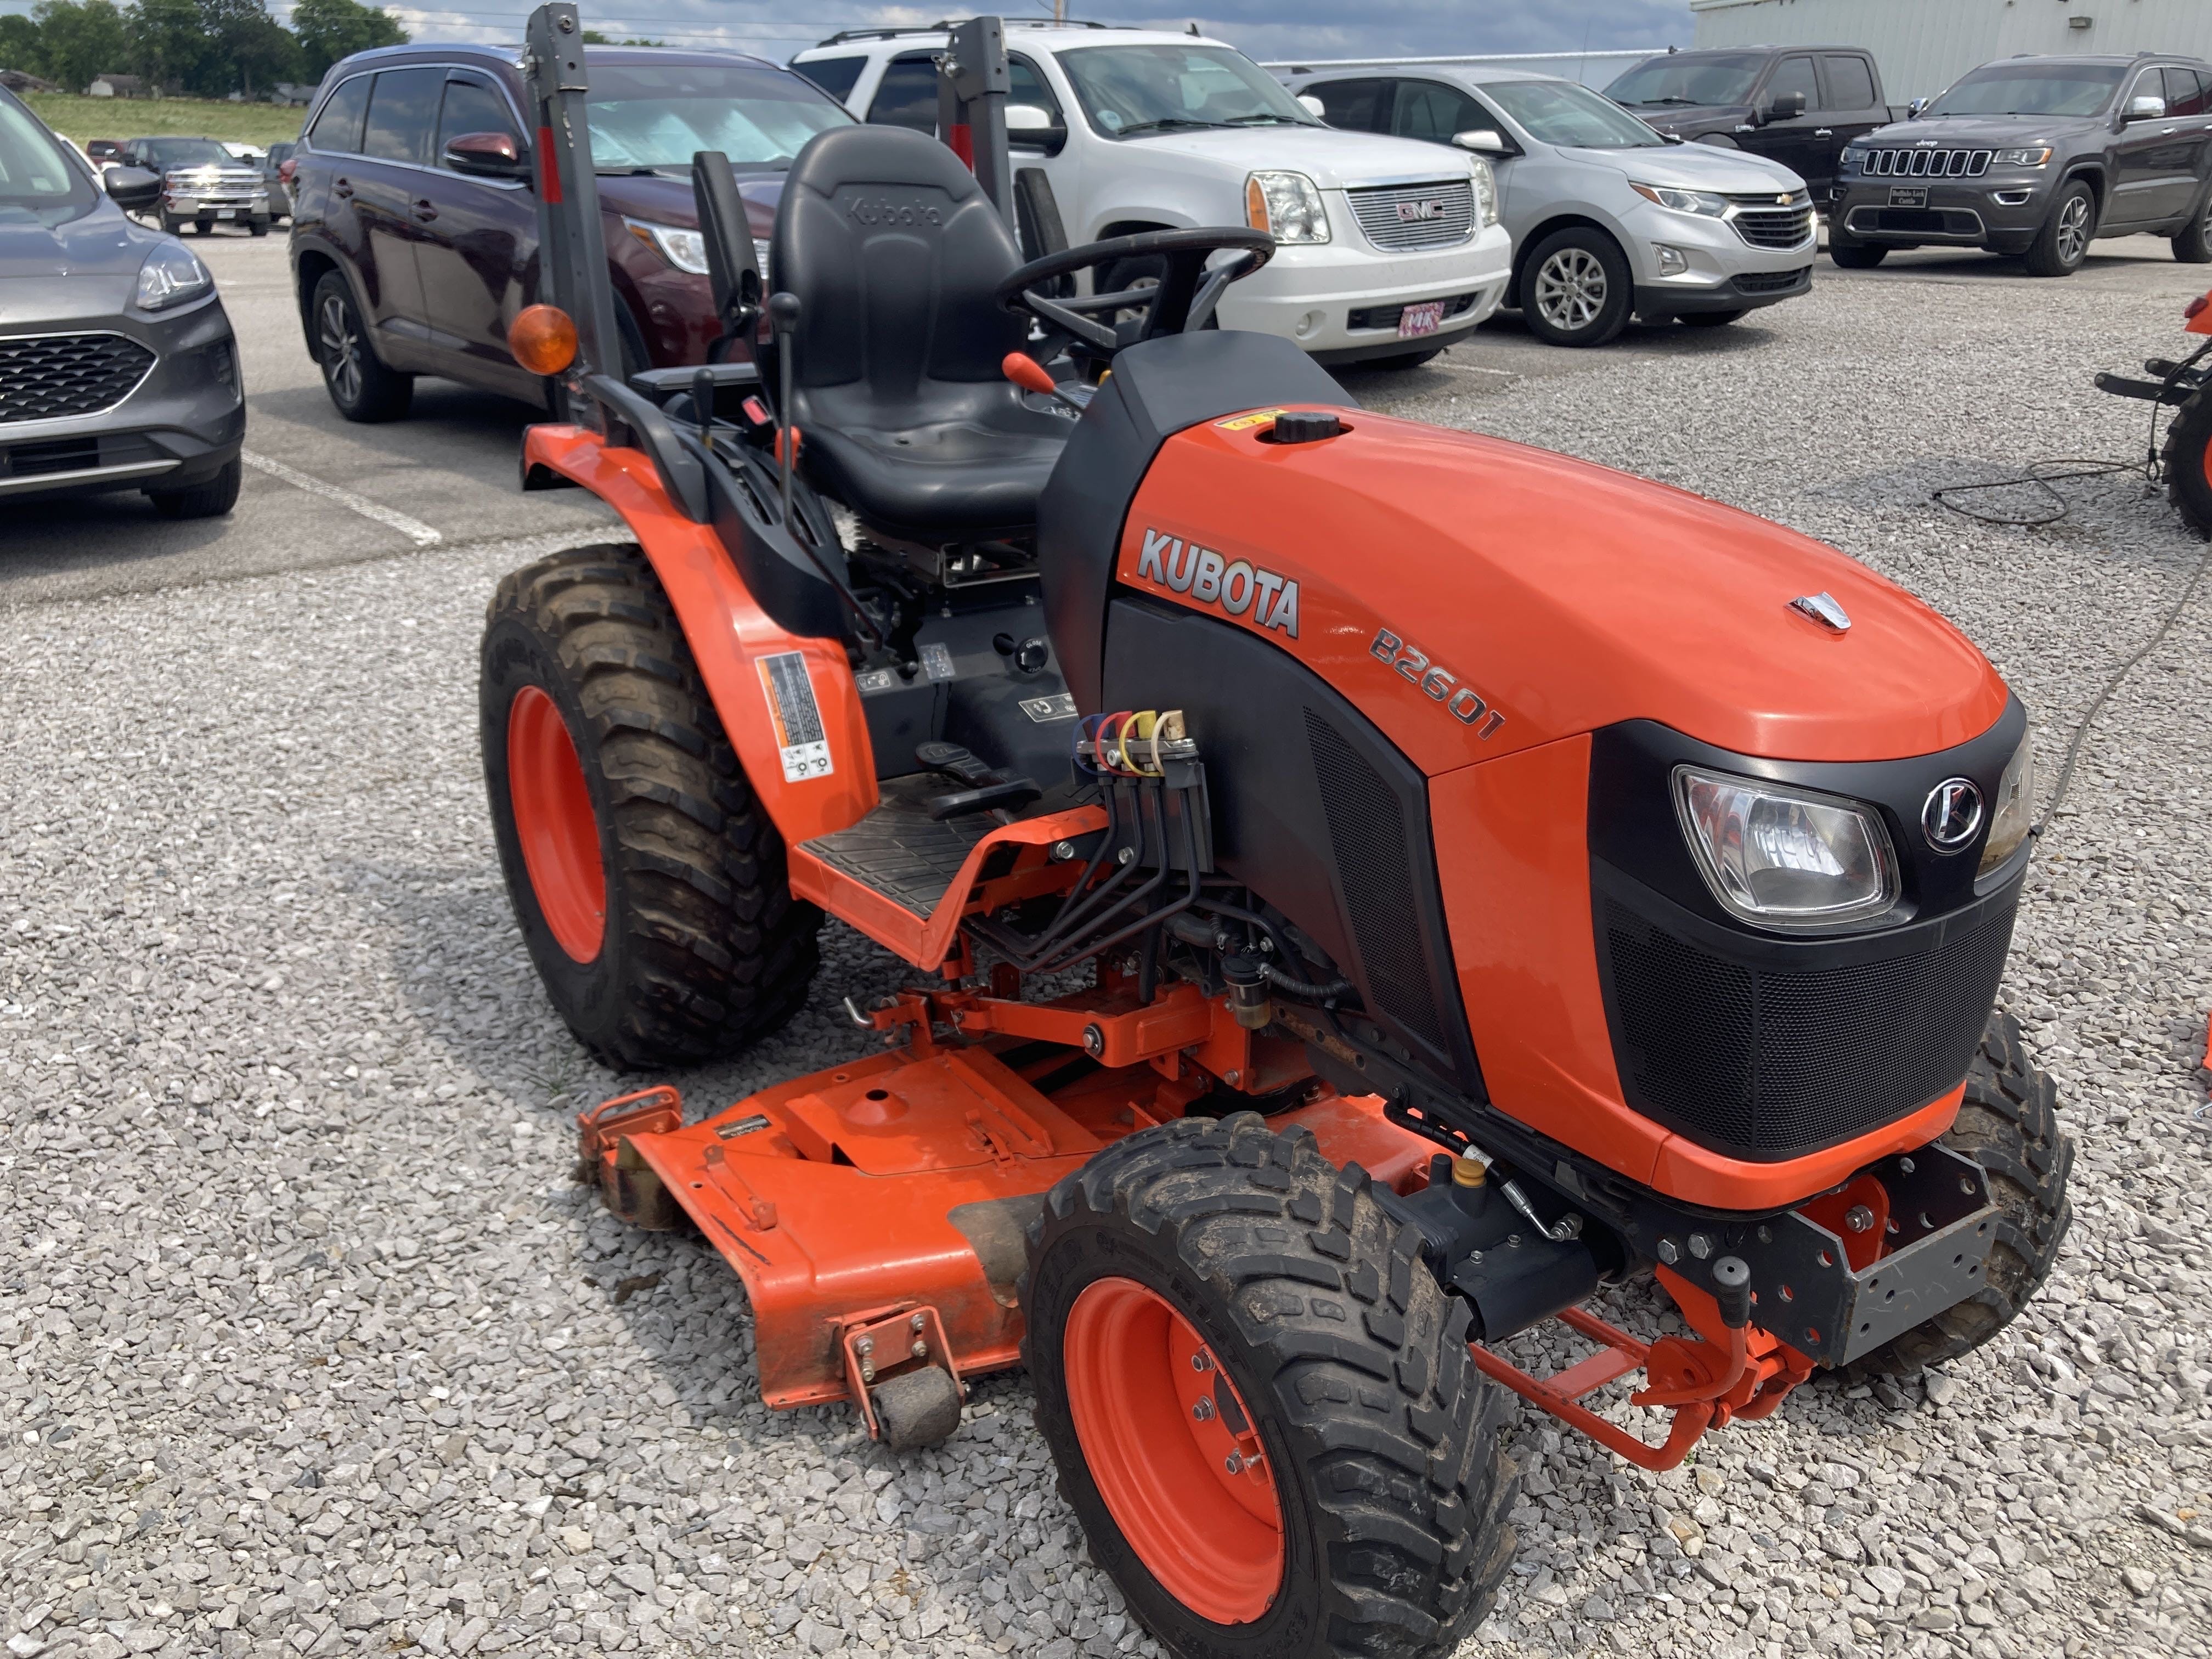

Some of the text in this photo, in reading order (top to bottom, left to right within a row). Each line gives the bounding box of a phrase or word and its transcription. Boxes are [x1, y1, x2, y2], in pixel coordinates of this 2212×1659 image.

[843, 196, 944, 226] Kubota
[1396, 199, 1446, 221] GMC
[1137, 527, 1300, 640] KUBOTA
[1026, 640, 1042, 648] CLOSE
[1369, 627, 1506, 741] B2601
